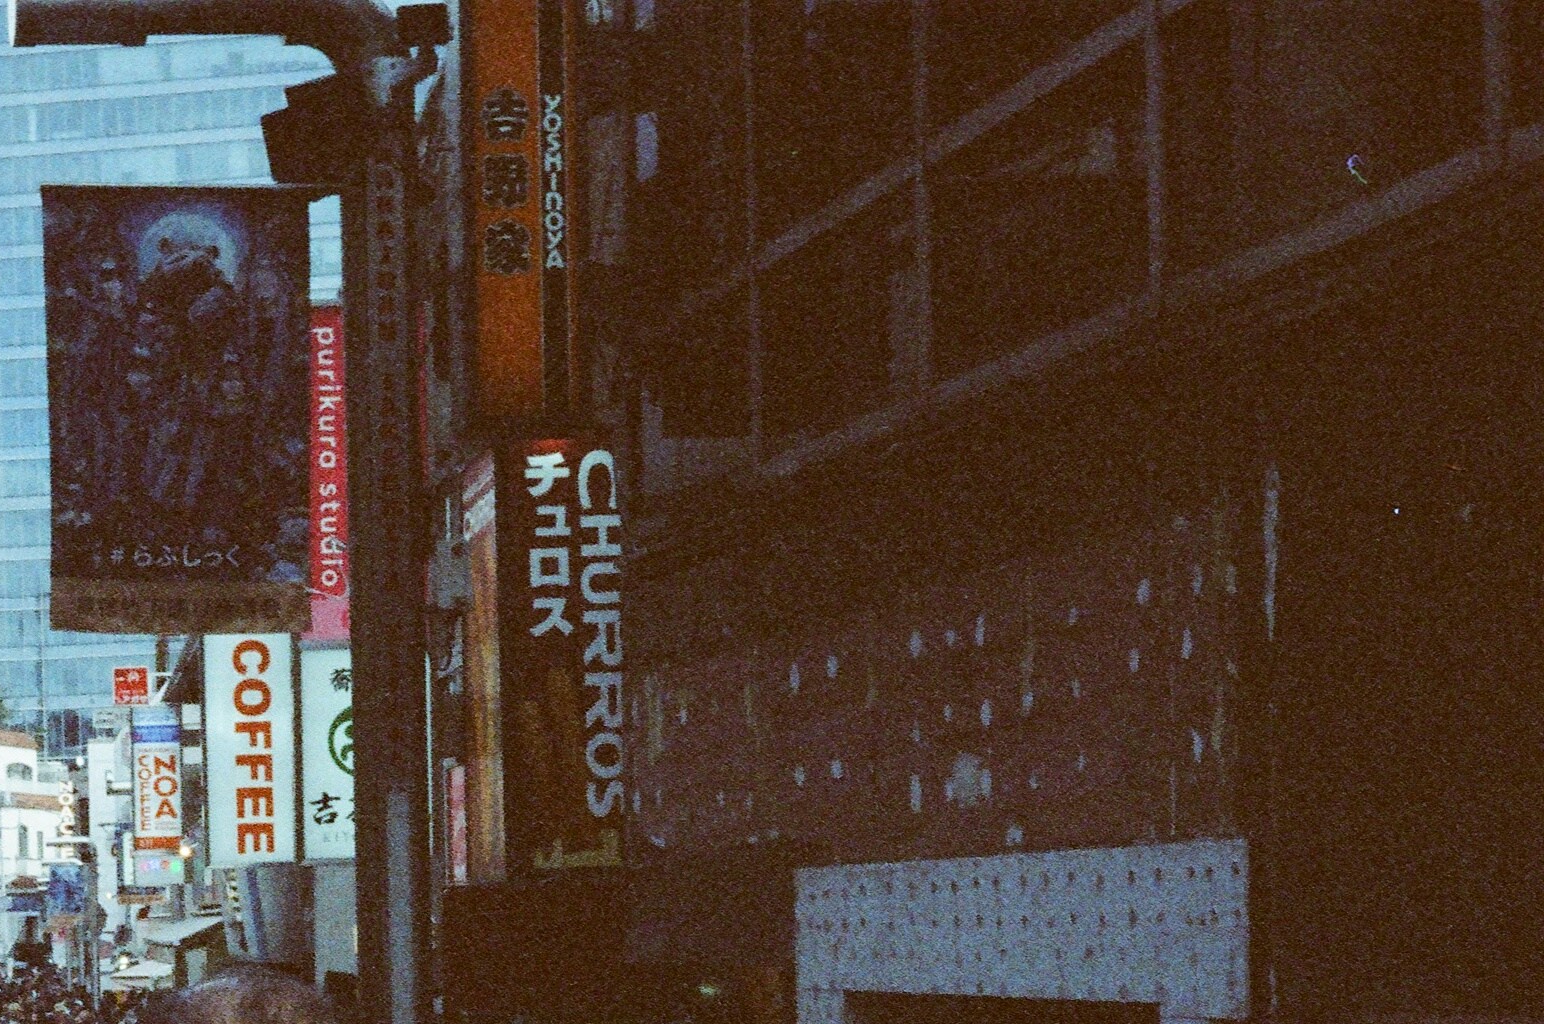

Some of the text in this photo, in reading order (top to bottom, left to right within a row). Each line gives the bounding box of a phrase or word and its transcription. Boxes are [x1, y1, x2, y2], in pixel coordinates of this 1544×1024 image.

[311, 327, 349, 589] purikuro studio
[524, 451, 574, 637] チュロス
[578, 449, 624, 818] CHURROS
[138, 753, 152, 831] COFFEE
[153, 754, 178, 819] NOA
[232, 639, 274, 855] COFFEE
[308, 791, 354, 826] 吉
